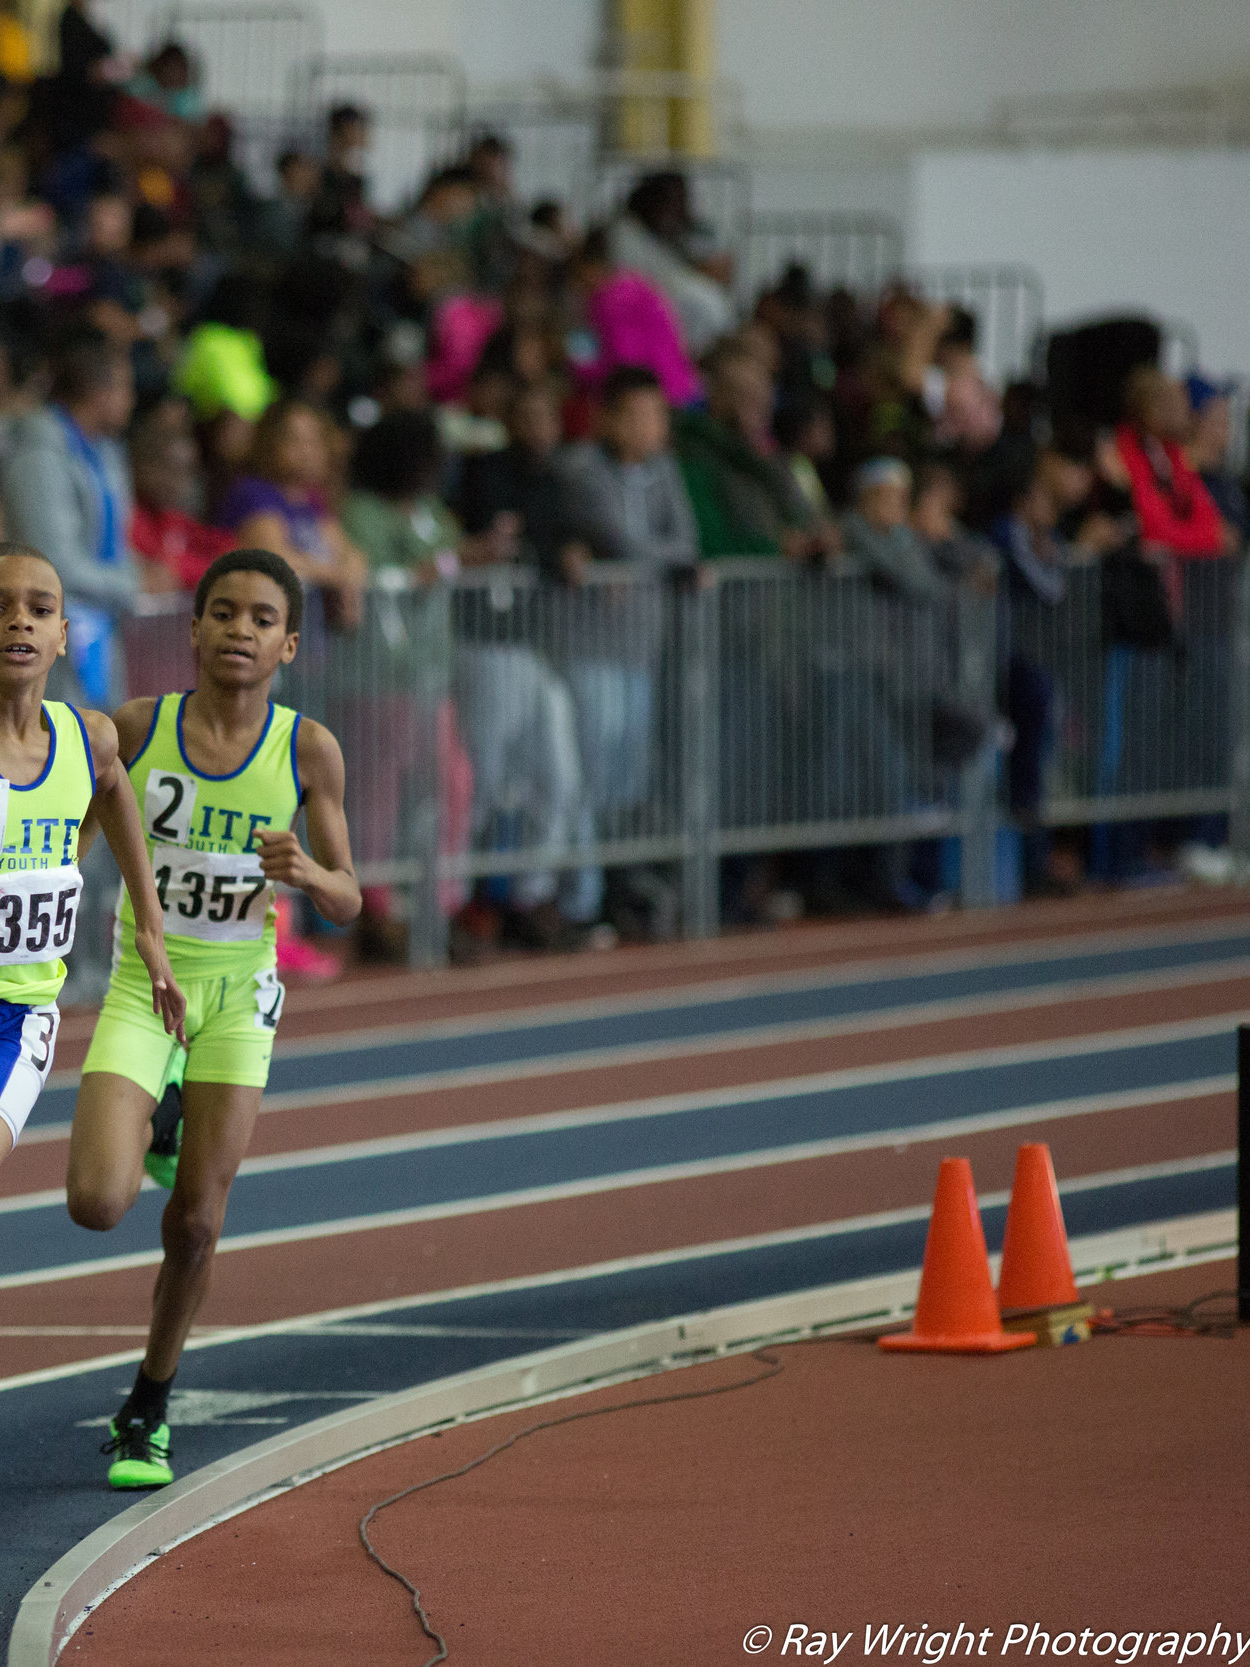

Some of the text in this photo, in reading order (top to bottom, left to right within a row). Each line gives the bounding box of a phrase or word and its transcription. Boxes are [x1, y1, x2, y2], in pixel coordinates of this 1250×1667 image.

[152, 776, 184, 839] 2
[175, 839, 228, 854] OUTH
[155, 865, 266, 922] 1357
[30, 1012, 55, 1072] 3
